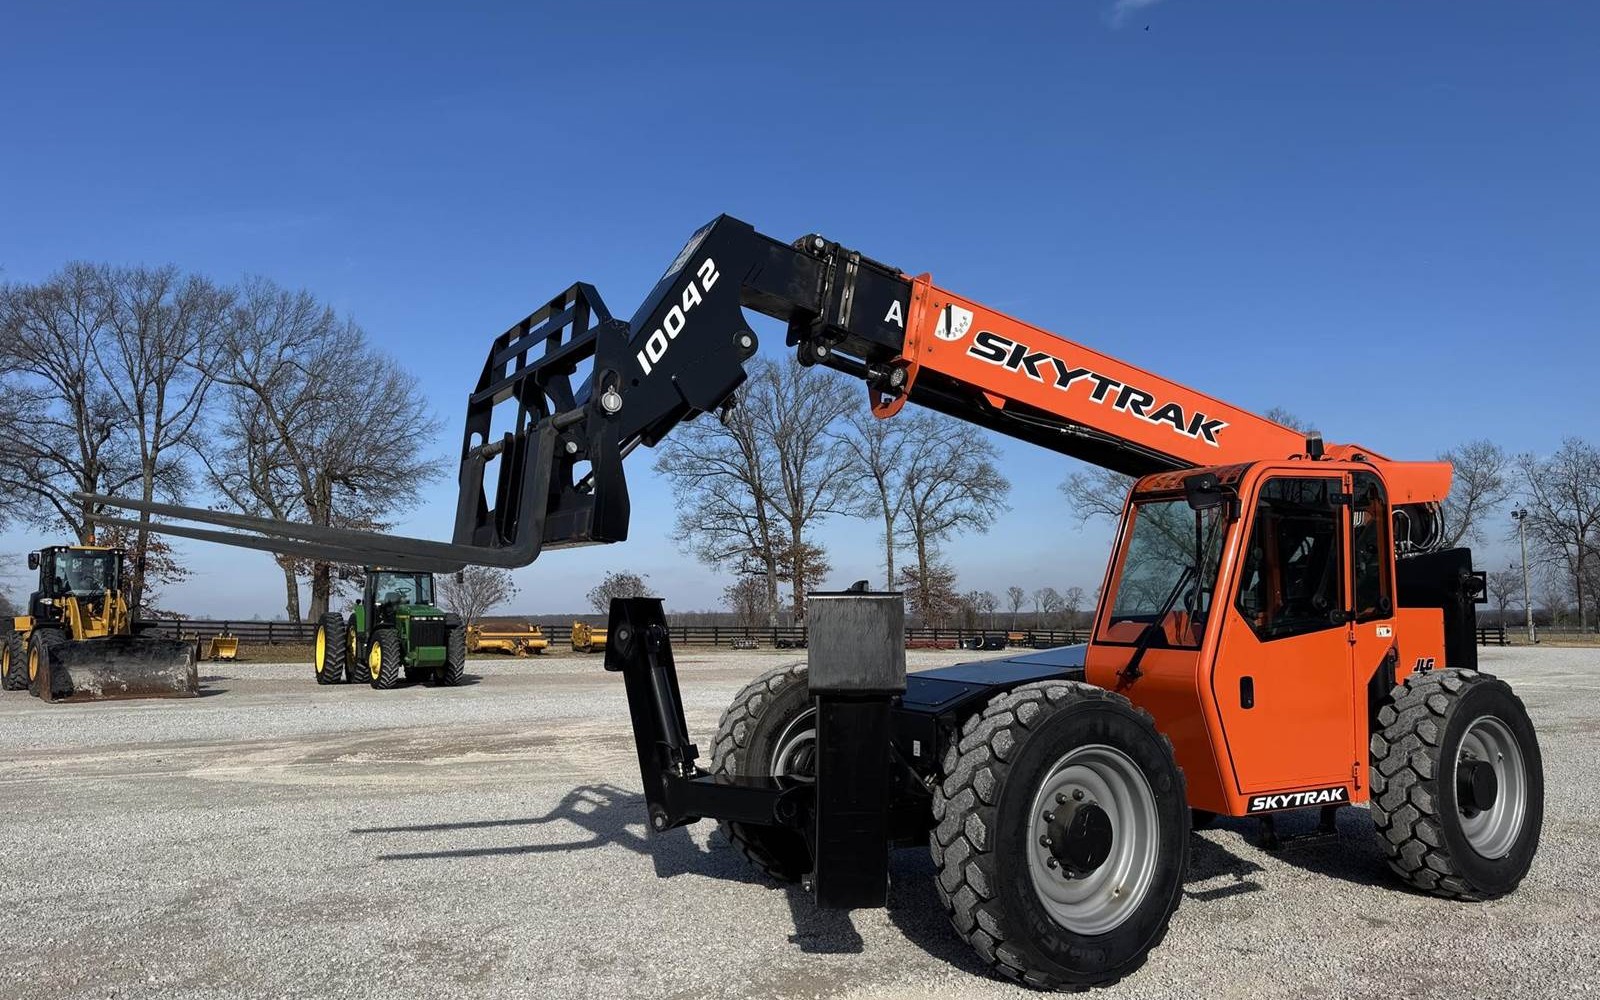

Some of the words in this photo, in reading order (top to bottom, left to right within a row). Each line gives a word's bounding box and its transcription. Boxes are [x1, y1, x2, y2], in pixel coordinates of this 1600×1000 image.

[637, 258, 720, 375] 10042
[884, 300, 903, 328] A
[967, 331, 1228, 446] SKYTRAK
[1413, 658, 1434, 672] JLG
[1251, 788, 1344, 811] SKYTRAK
